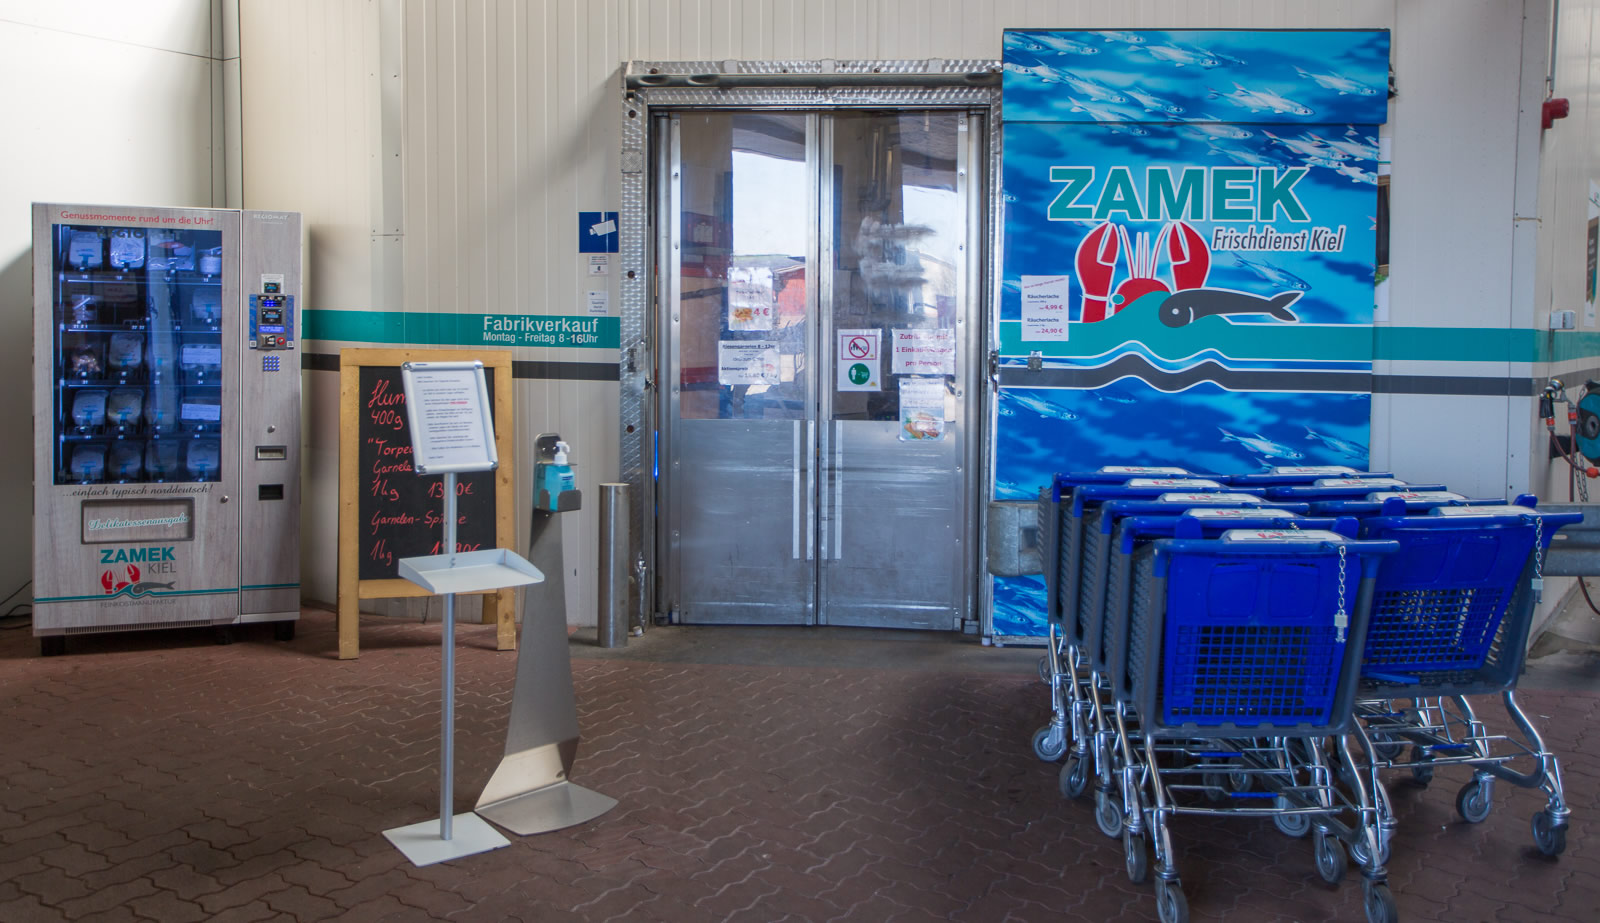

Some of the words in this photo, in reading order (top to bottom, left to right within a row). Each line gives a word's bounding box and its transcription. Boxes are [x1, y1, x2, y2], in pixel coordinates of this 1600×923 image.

[1047, 166, 1311, 222] ZAMEK
[60, 211, 137, 222] Genussmomente
[139, 215, 160, 223] rund
[178, 216, 191, 224] die
[194, 217, 214, 225] Uhr!
[1212, 225, 1307, 251] Frischdienst
[1309, 225, 1346, 252] Kiel
[753, 307, 761, 316] 4
[762, 307, 770, 316] €
[483, 316, 599, 333] Fabrikverkauf
[483, 332, 516, 343] Montag
[524, 333, 556, 344] Freitag
[558, 334, 565, 343] 8
[368, 379, 408, 408] Hum
[371, 410, 404, 431] 400g
[112, 485, 147, 498] typisch
[150, 484, 213, 496] norddeutsch!
[88, 511, 190, 531] Delikatessenausgabe
[100, 546, 176, 564] ZAMEK
[148, 562, 177, 574] KIEL
[100, 599, 177, 608] FEINKOSTMANUFAKTUR
